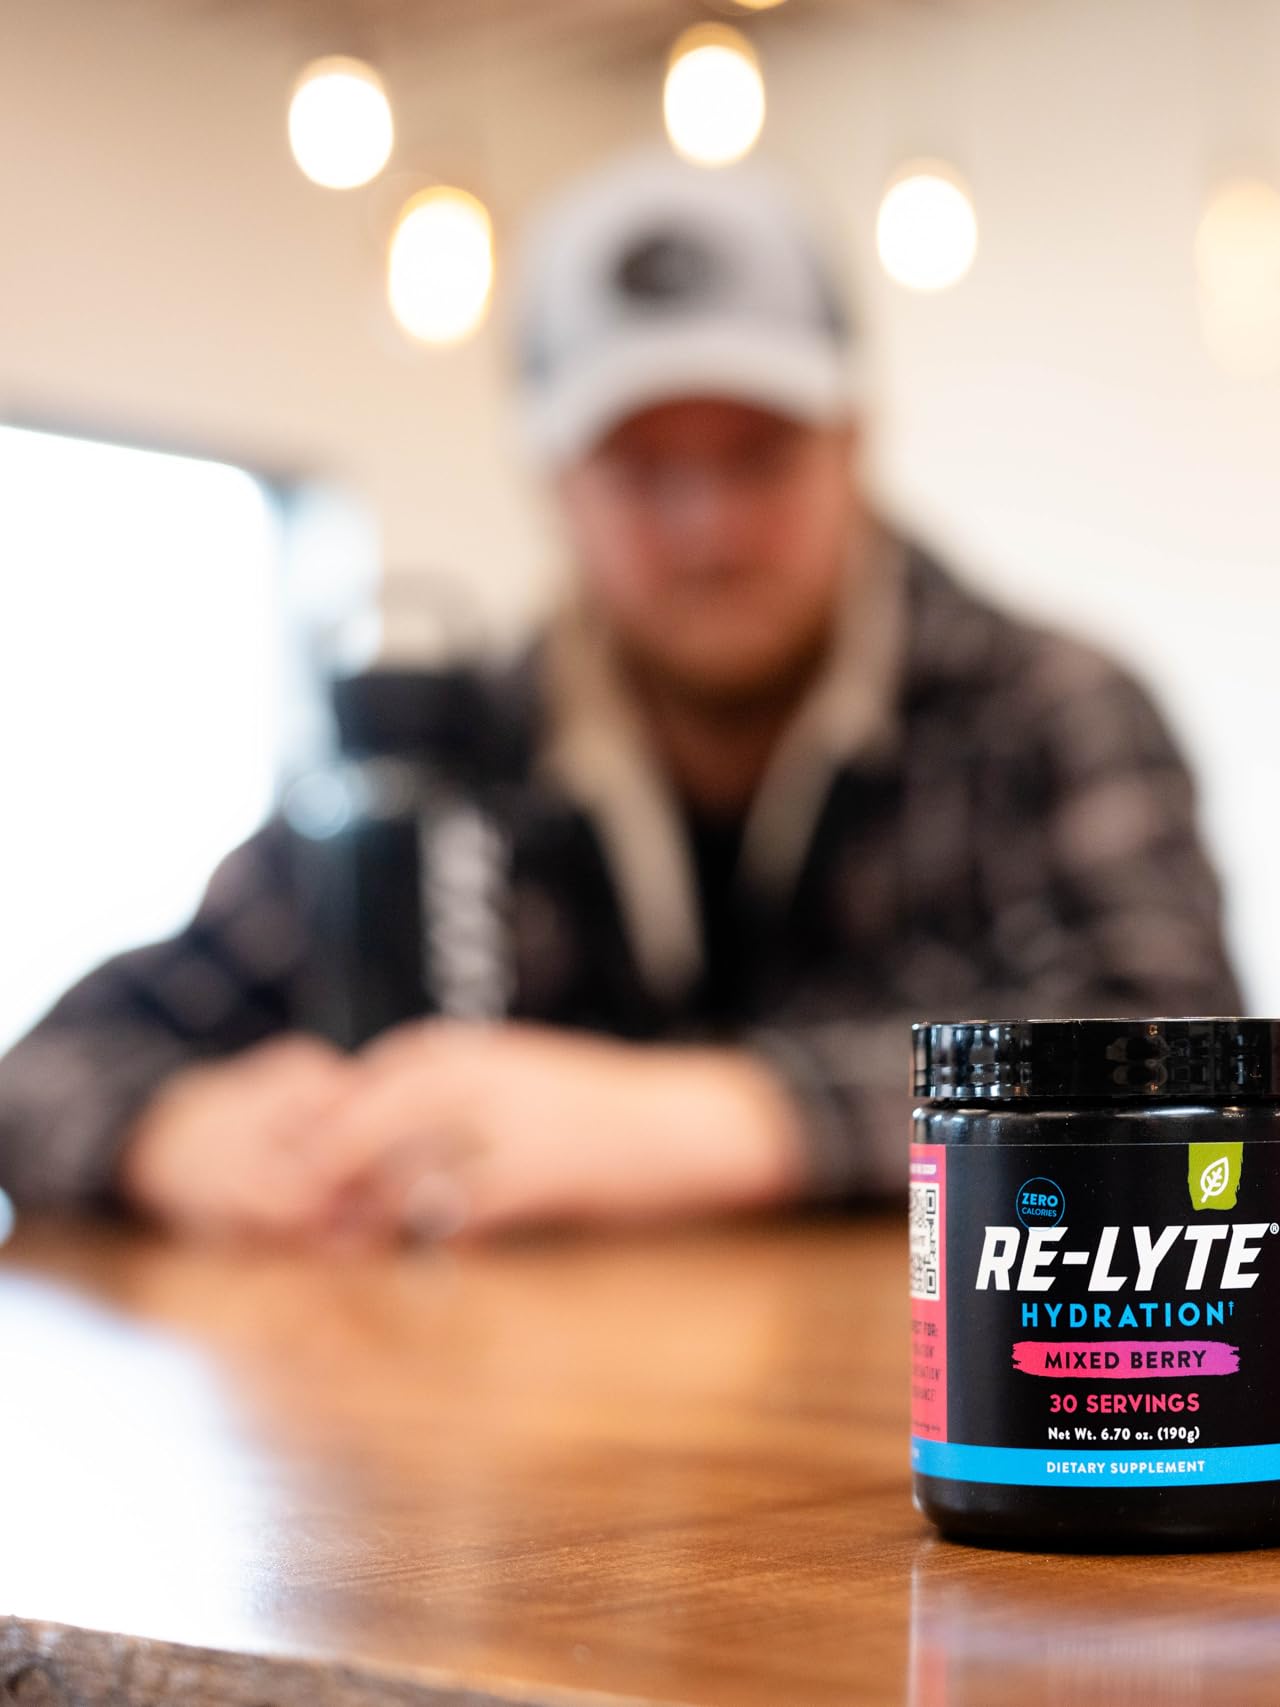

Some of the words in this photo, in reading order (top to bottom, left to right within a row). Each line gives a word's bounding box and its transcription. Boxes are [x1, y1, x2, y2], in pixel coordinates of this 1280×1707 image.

[1021, 1192, 1059, 1208] ZERO
[1021, 1207, 1057, 1218] CALORIES
[1044, 1351, 1120, 1370] MIXED
[1130, 1350, 1207, 1369] BERRY
[1050, 1393, 1078, 1414] 30
[1086, 1392, 1200, 1414] SERVINGS
[1048, 1427, 1071, 1441] Net
[1074, 1427, 1097, 1441] Wt.
[1100, 1428, 1131, 1441] 6.70
[1135, 1432, 1154, 1441] oz.
[1157, 1426, 1200, 1444] (190g)
[1046, 1461, 1106, 1475] DIETARY
[1110, 1460, 1206, 1475] SUPPLEMENT
